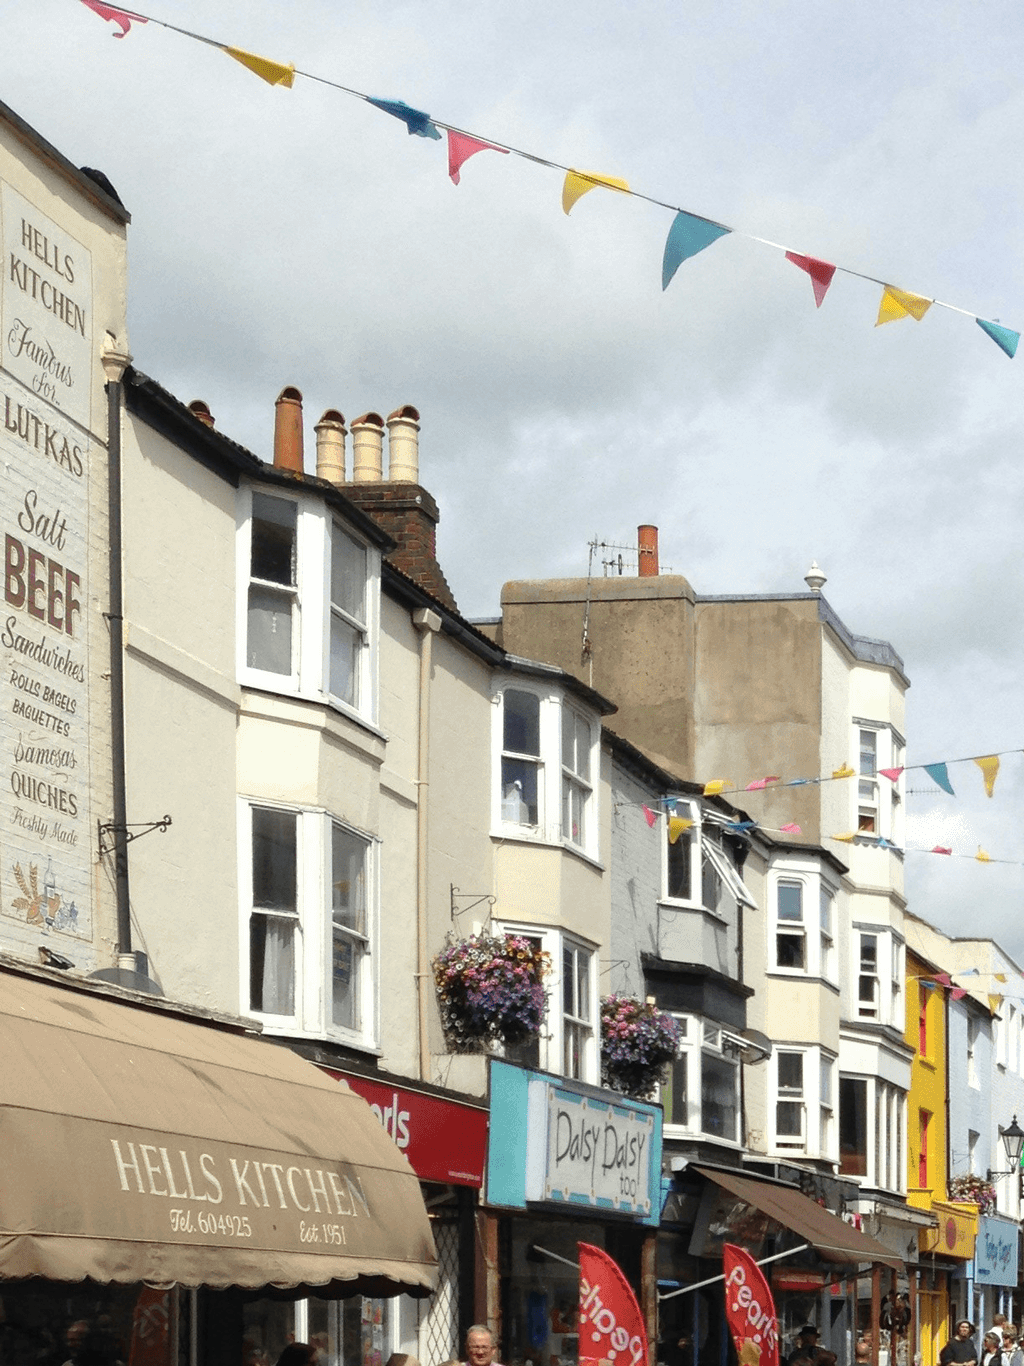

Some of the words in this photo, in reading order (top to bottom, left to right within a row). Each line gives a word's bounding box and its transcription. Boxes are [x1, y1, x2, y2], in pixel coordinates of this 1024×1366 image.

[21, 217, 74, 284] HELLS
[10, 251, 87, 338] KITCHEN
[7, 317, 76, 388] Famous
[4, 394, 84, 478] LUTKAS
[17, 489, 69, 551] Salt
[4, 532, 82, 638] BEEF
[1, 615, 86, 684] Sandwiches
[9, 668, 41, 698] ROLLS
[42, 686, 77, 715] BAGELS
[12, 698, 71, 738] BAGUETTES
[13, 731, 78, 770] Samosas
[10, 770, 79, 818] QUICHES
[9, 805, 49, 841] Freshly
[49, 821, 79, 848] Made
[110, 1138, 224, 1204] HELLS
[229, 1157, 371, 1219] KITCHEN
[555, 1107, 601, 1188] Daisy
[602, 1121, 646, 1186] Daisy
[619, 1171, 637, 1198] too
[169, 1208, 197, 1235] Tel.
[197, 1212, 252, 1238] 604925
[299, 1220, 321, 1244] Est.
[321, 1225, 347, 1245] 1951
